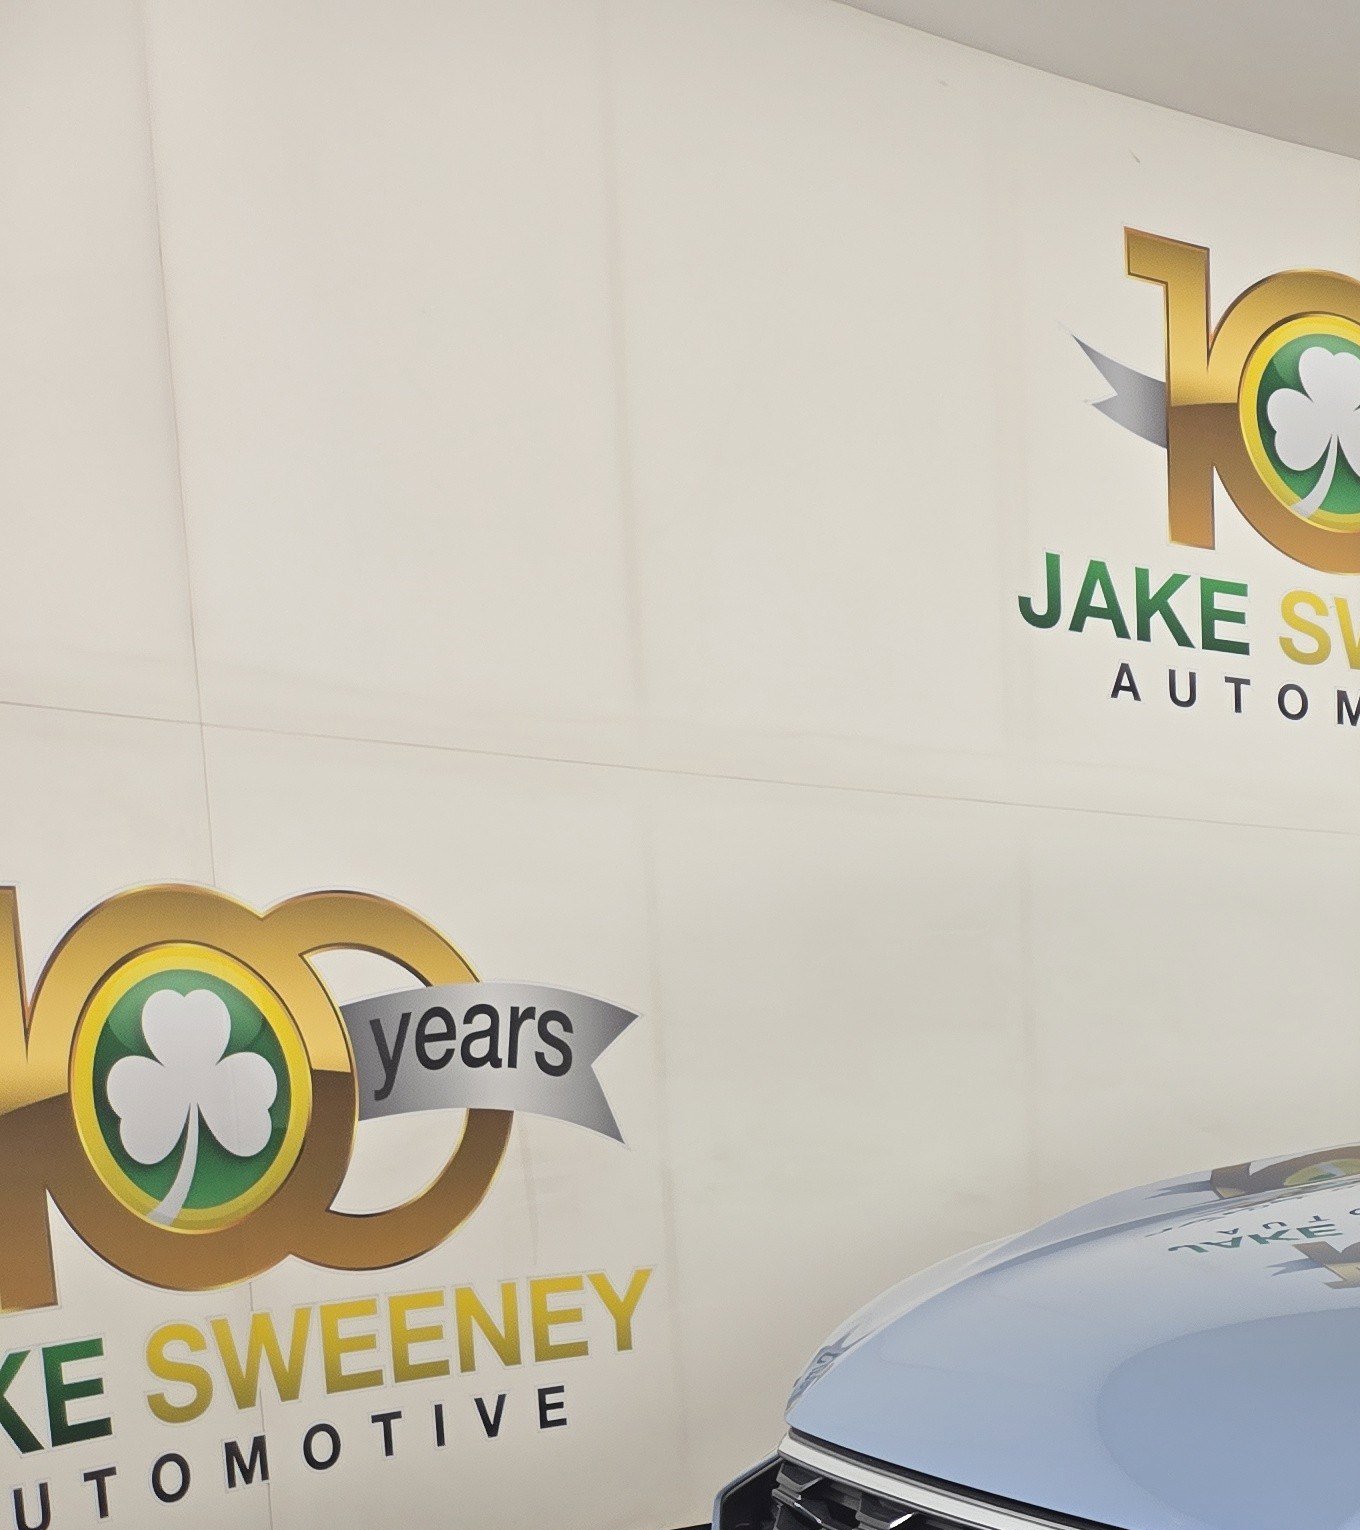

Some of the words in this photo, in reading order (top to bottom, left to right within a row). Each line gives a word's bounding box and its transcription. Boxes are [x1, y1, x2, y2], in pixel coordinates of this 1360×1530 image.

[1018, 552, 1251, 655] JAKE
[369, 1003, 573, 1101] years
[145, 1268, 653, 1424] SWEENEY
